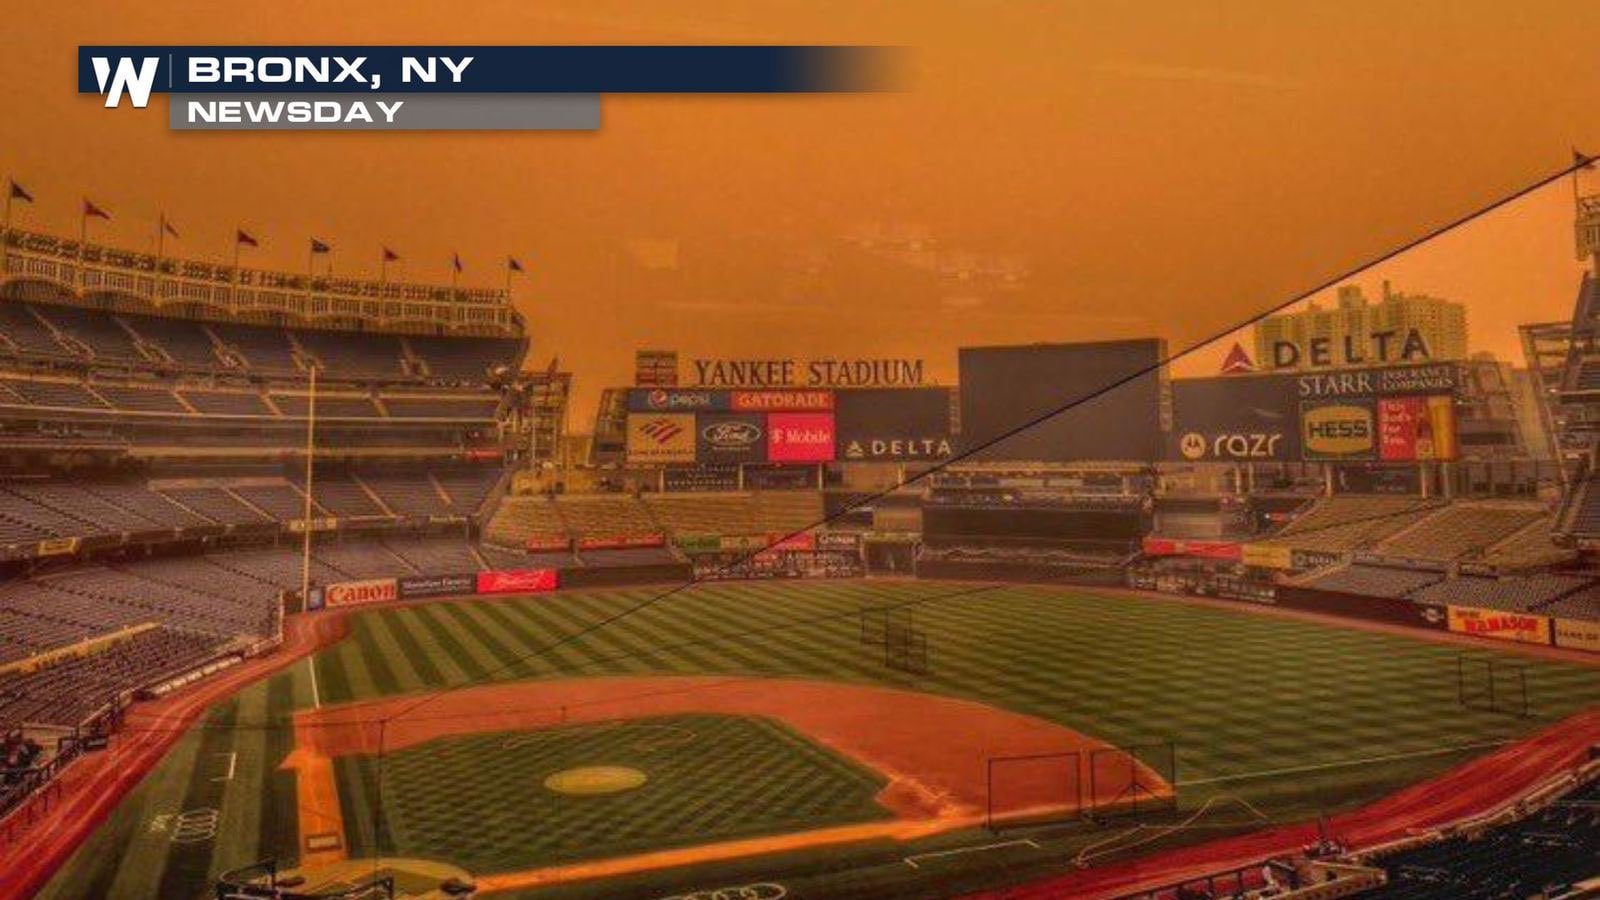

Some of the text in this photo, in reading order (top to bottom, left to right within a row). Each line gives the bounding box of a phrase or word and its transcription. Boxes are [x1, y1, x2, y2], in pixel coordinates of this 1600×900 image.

[1274, 328, 1430, 368] DELTA
[694, 359, 924, 386] YANKEE STADIUM
[1298, 372, 1373, 396] STARR
[671, 393, 711, 409] pepsi
[738, 393, 829, 409] GATORADE
[712, 424, 750, 441] Ford
[786, 429, 831, 444] Mobile
[1309, 421, 1368, 438] HESS
[871, 440, 952, 456] DELTA
[1213, 434, 1282, 457] razr
[327, 580, 396, 602] Canon
